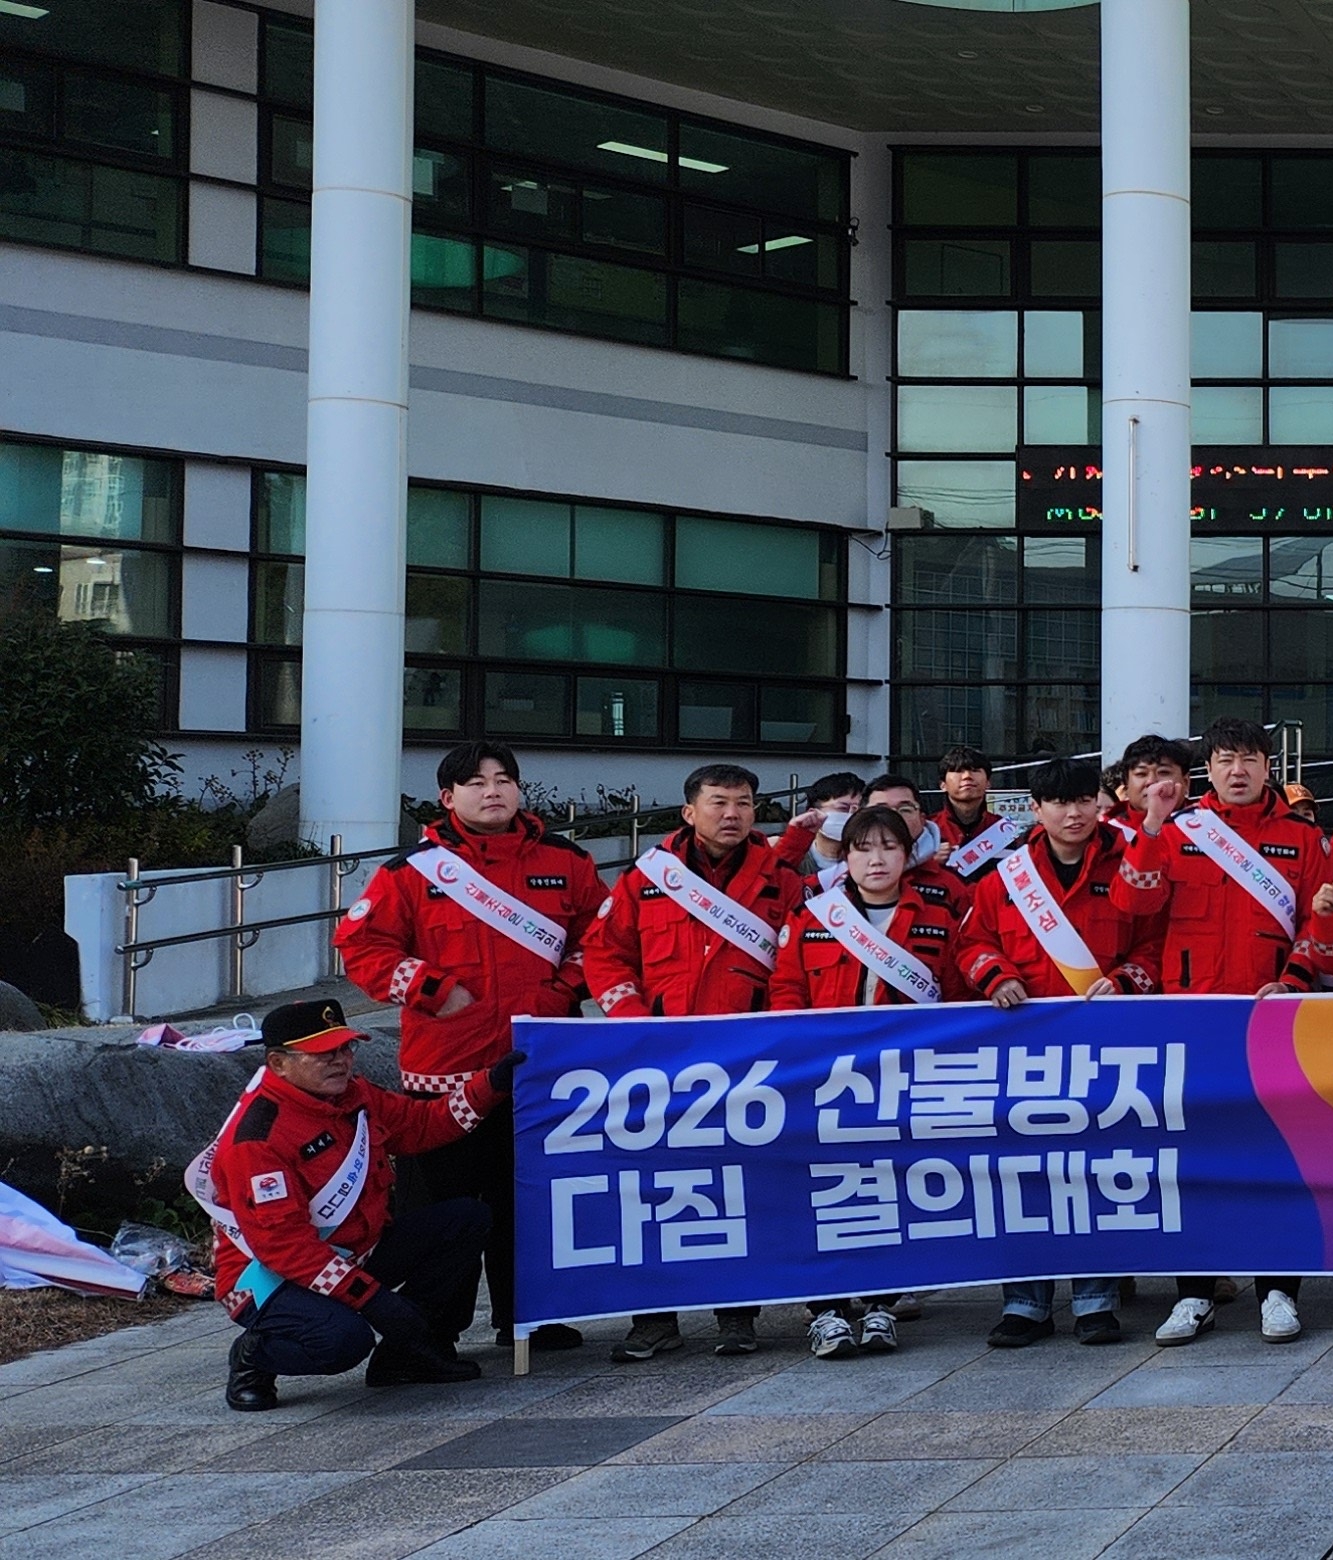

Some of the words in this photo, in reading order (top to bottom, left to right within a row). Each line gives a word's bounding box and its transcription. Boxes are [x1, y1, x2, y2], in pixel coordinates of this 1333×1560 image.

[1005, 854, 1059, 934] 산불조심
[543, 1059, 788, 1155] 2026
[814, 1042, 1186, 1142] 산불방지
[550, 1164, 750, 1269] 다짐
[809, 1148, 1183, 1252] 결의대회
